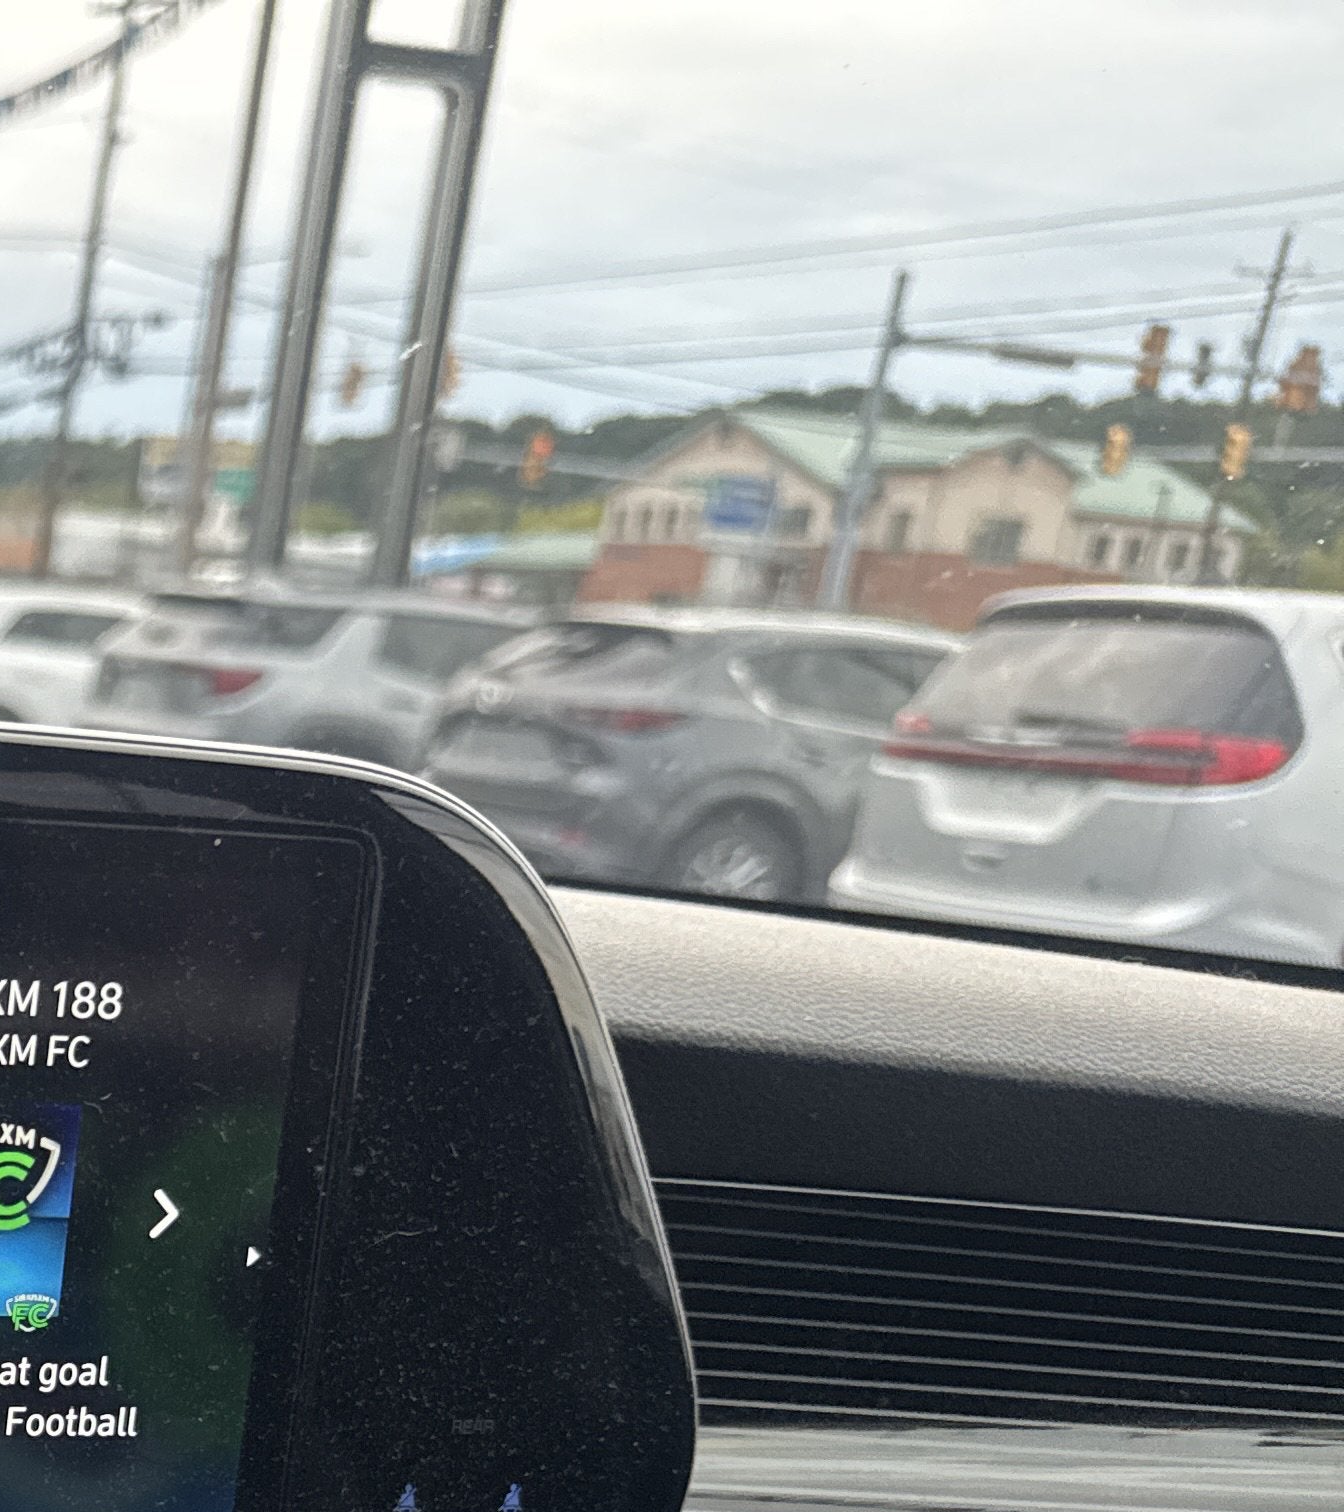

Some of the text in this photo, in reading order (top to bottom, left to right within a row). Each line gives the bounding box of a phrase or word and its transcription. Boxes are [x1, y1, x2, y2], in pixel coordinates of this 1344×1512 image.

[53, 980, 123, 1020] 188
[47, 1035, 90, 1067] FC
[12, 1302, 49, 1331] FC
[39, 1356, 108, 1392] goal
[6, 1407, 137, 1436] Football
